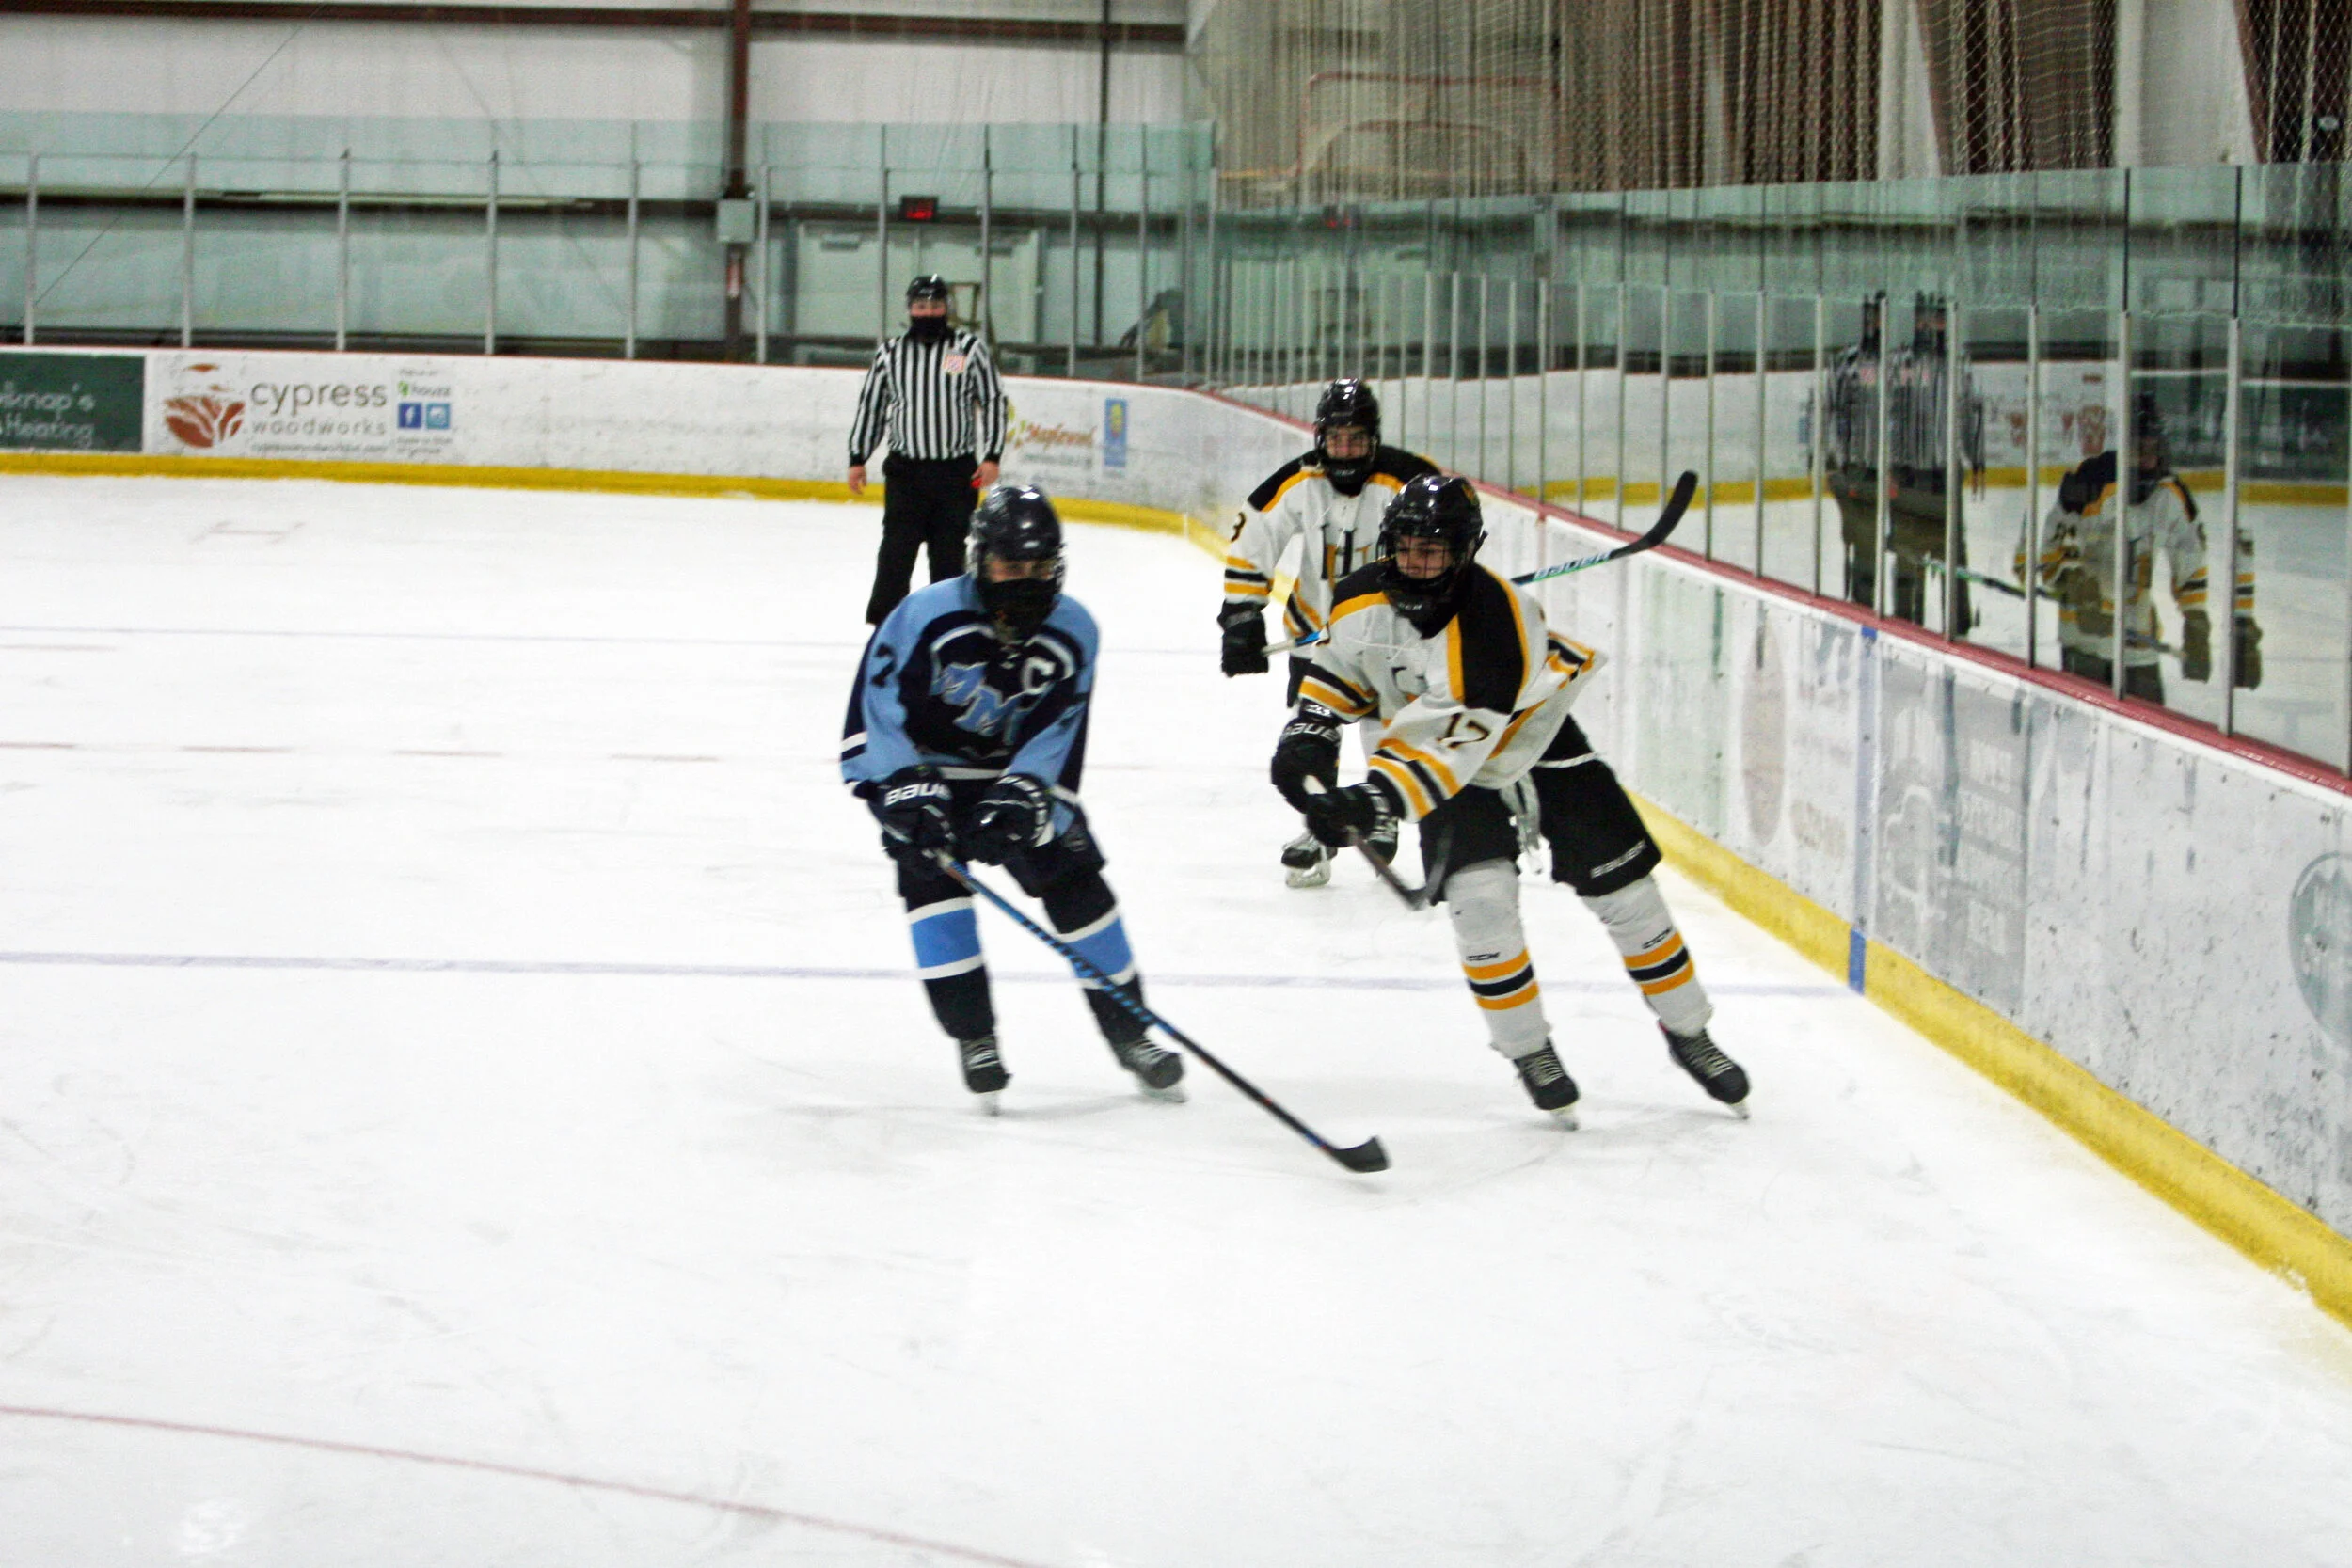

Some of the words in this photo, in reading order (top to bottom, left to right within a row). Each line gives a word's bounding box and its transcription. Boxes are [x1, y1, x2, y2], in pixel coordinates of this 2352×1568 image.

[250, 381, 388, 416] cypress
[251, 418, 387, 436] woodworks
[1021, 657, 1057, 695] C
[1436, 712, 1482, 750] 17
